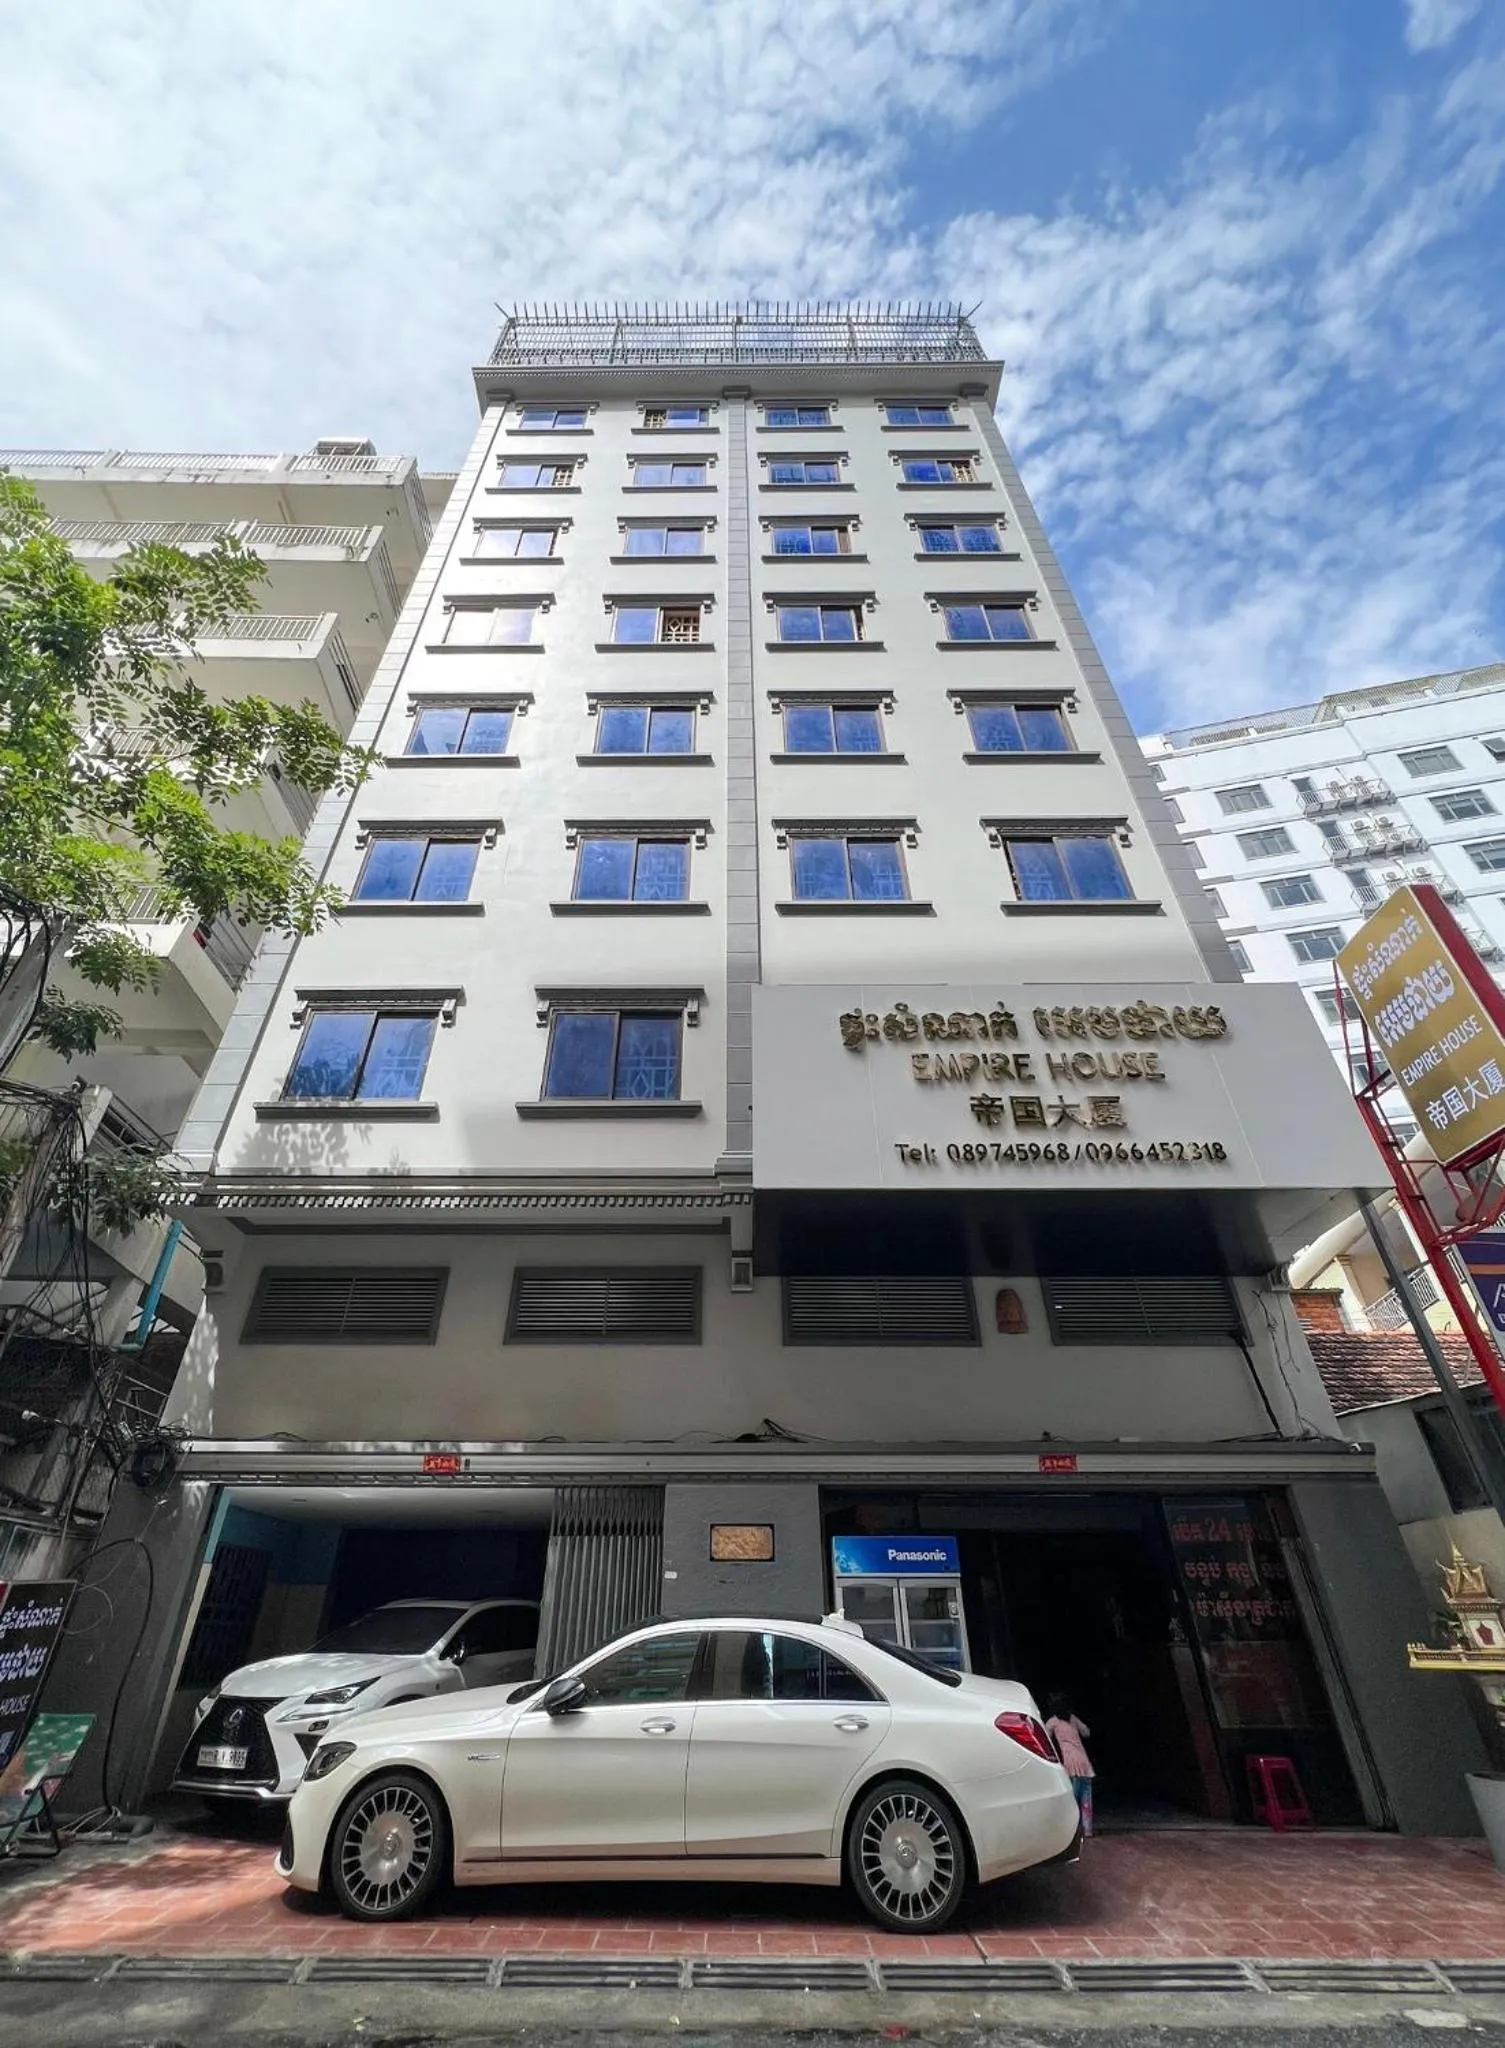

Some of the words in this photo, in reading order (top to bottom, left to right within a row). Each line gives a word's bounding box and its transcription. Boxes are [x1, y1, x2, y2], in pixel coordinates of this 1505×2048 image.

[912, 1053, 1036, 1081] EMPIRE
[1046, 1052, 1166, 1081] HOUSE
[1401, 1046, 1443, 1087] EMPIRE
[1439, 1015, 1483, 1056] HOUSE
[1425, 1058, 1505, 1129] 帝国大厦
[970, 1093, 1128, 1129] 帝国大厦
[895, 1143, 937, 1164] Tel:
[887, 1548, 947, 1561] Panasonic
